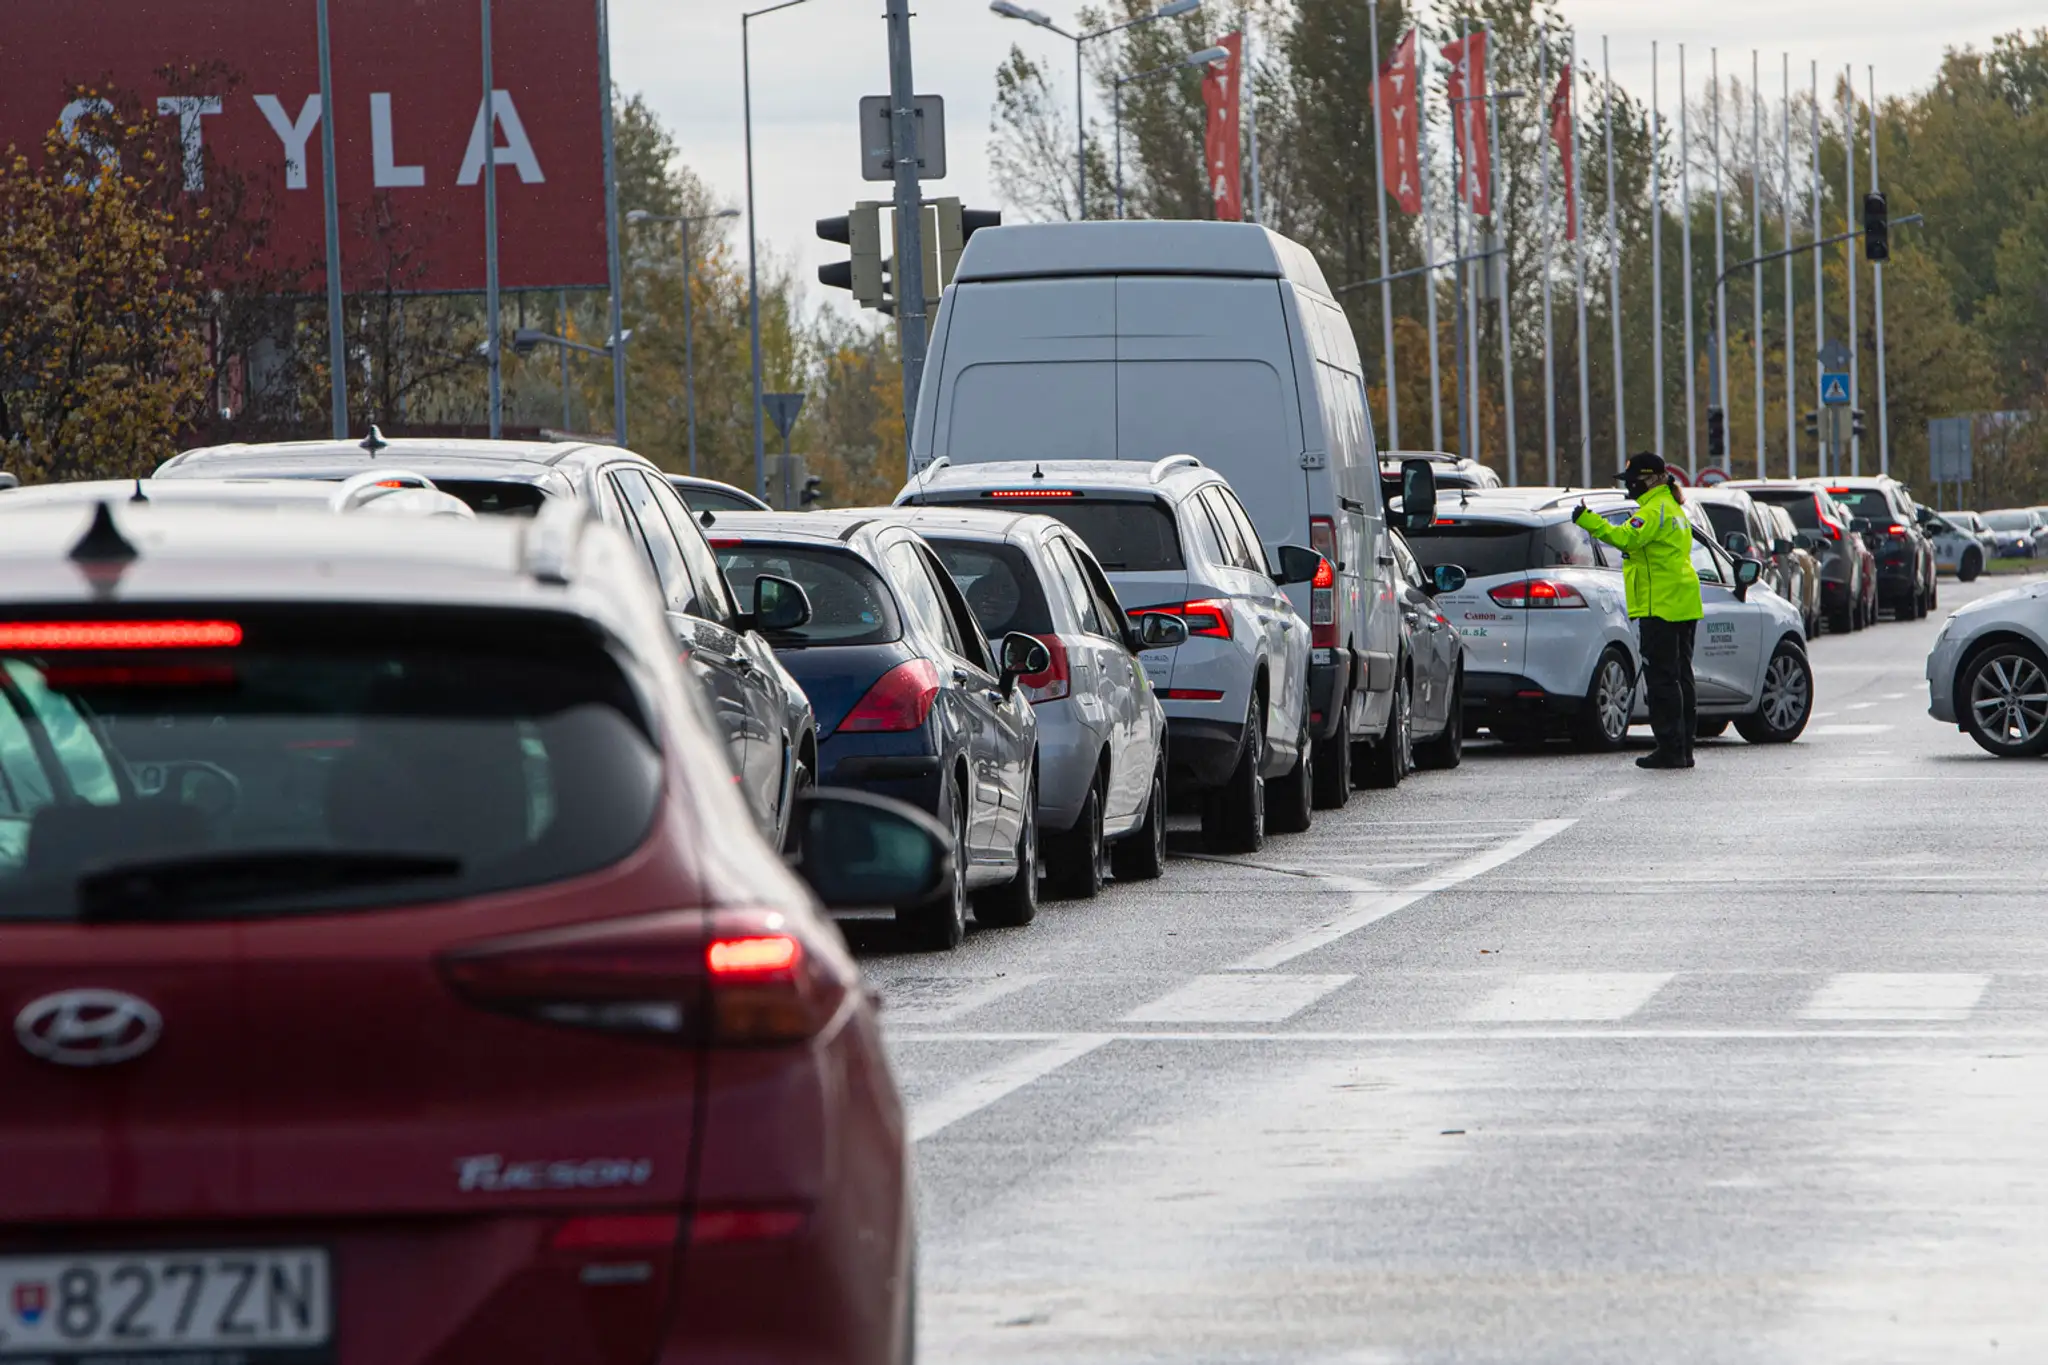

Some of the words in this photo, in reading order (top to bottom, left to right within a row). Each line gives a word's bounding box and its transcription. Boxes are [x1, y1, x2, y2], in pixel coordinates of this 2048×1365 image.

[59, 88, 546, 193] STYLA
[1464, 612, 1496, 621] Canon
[56, 1260, 313, 1339] 827ZN
